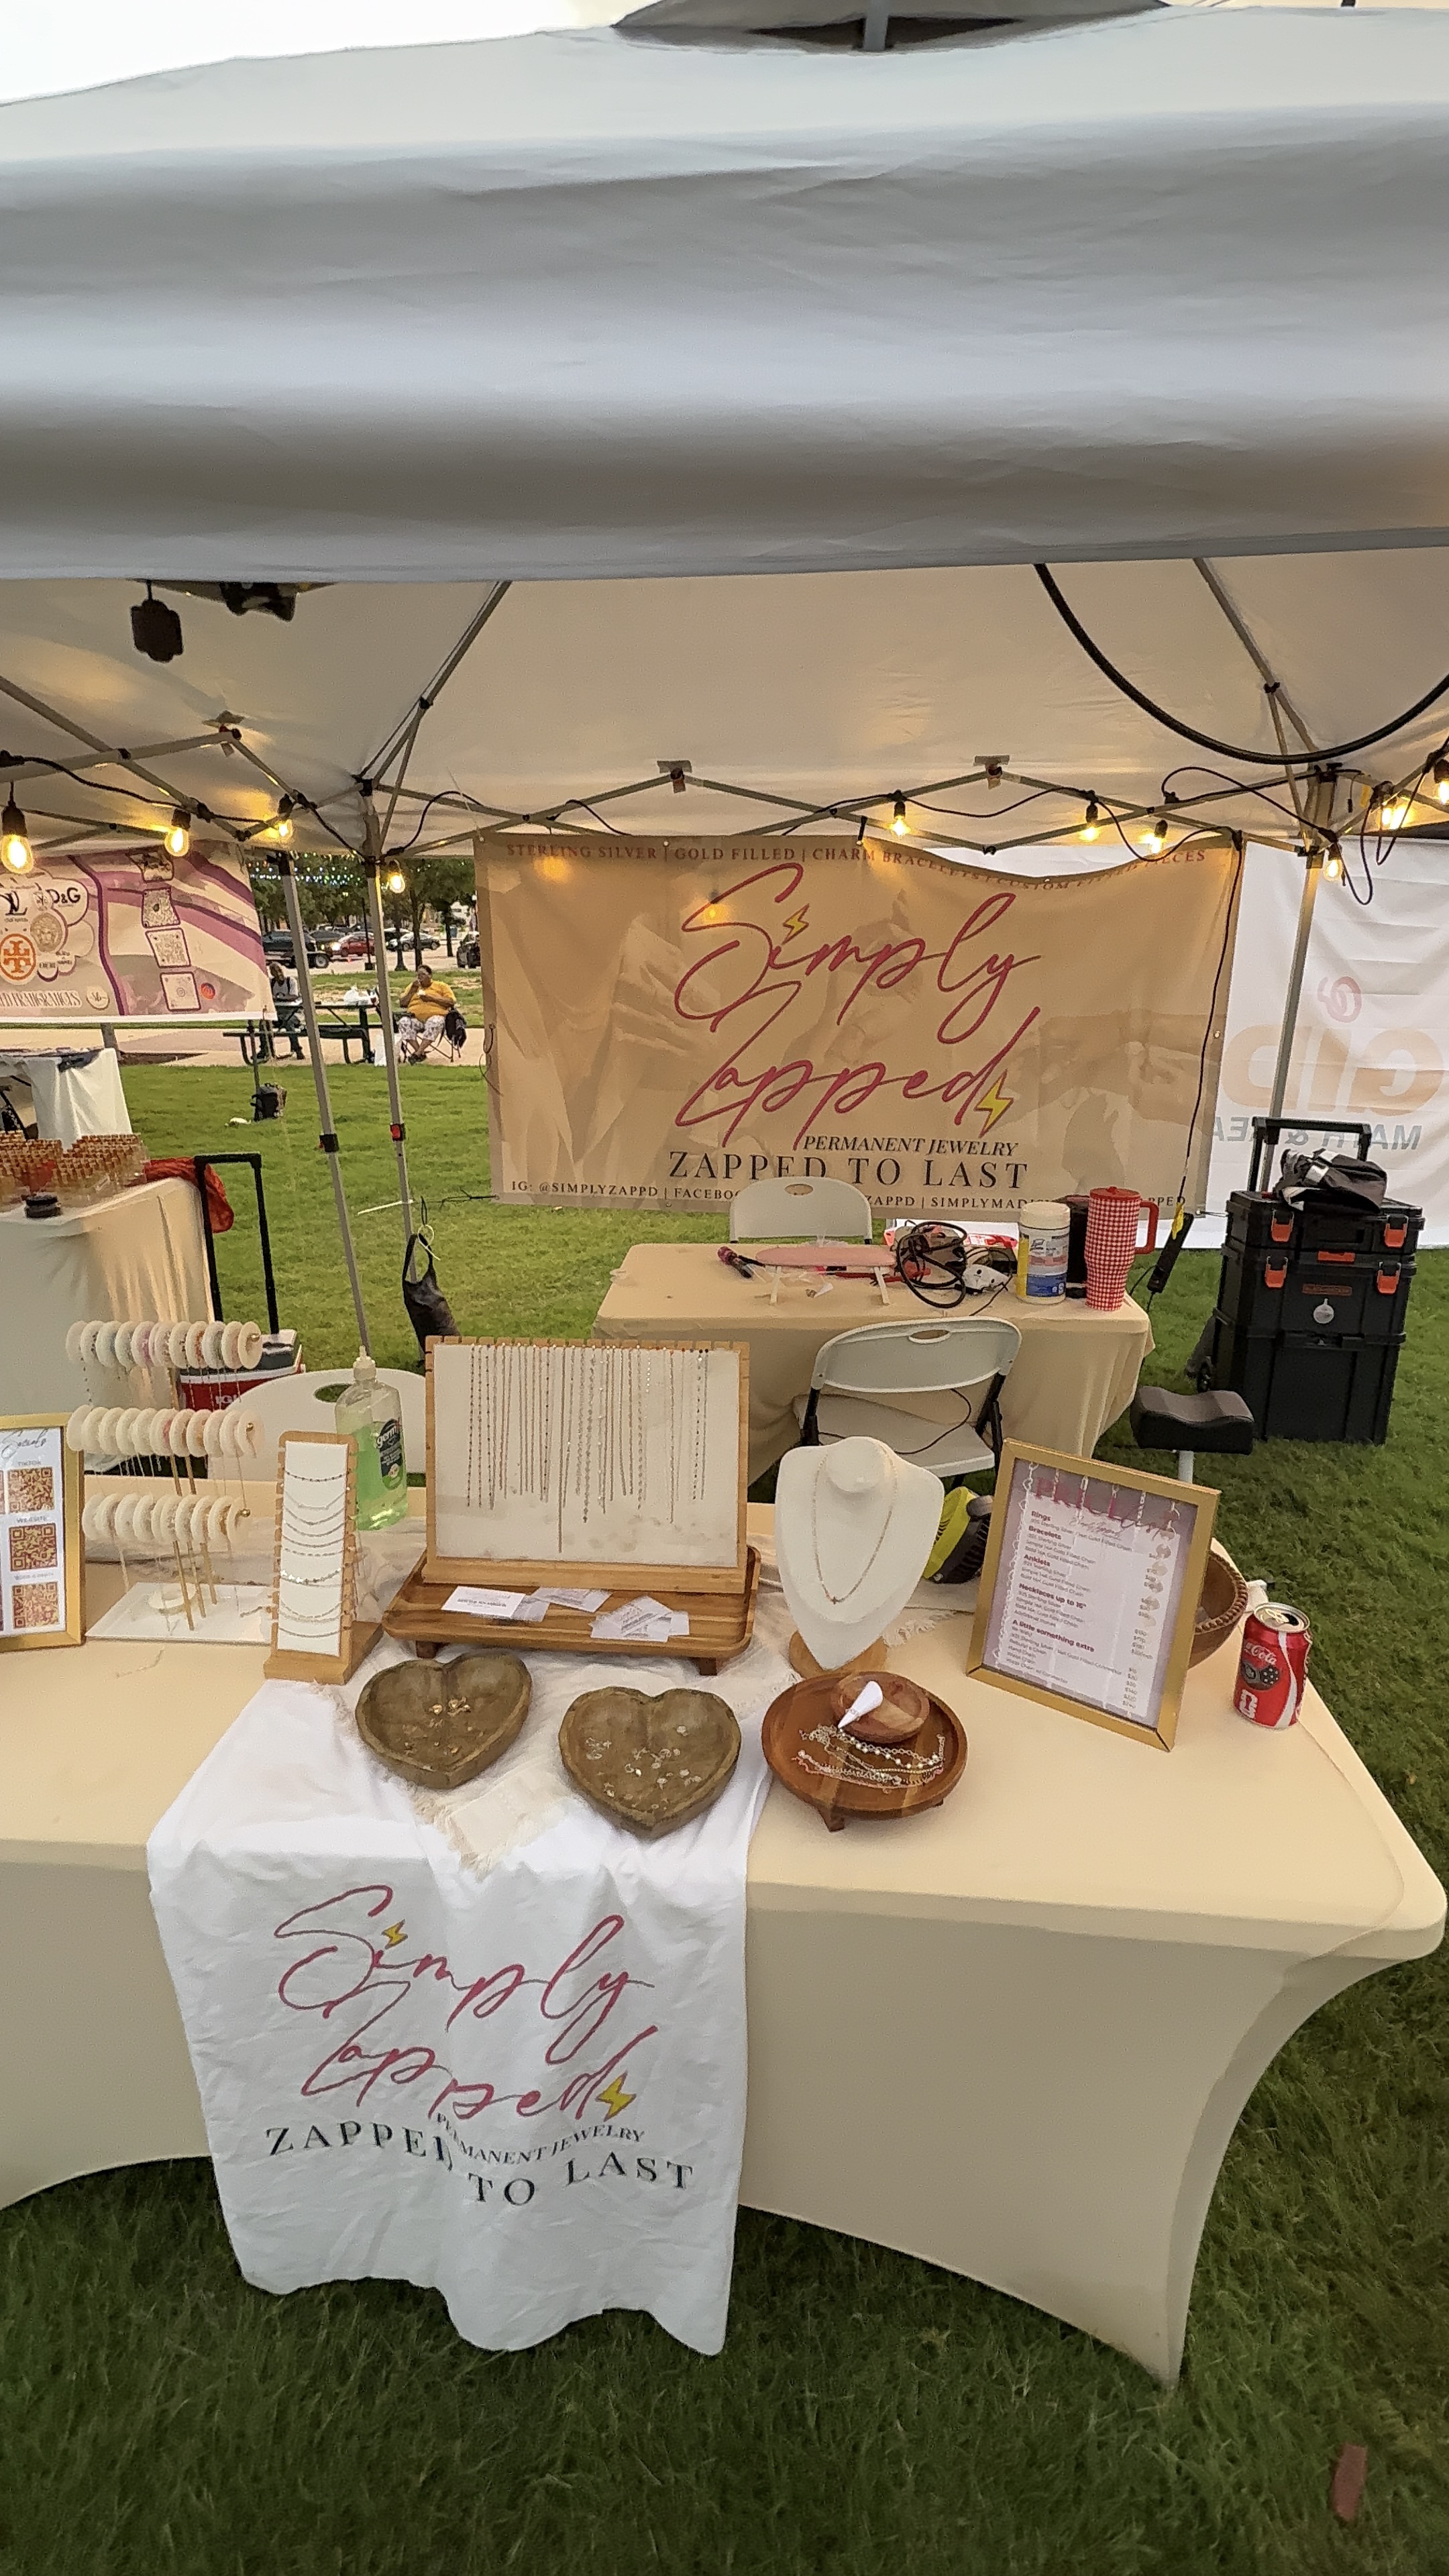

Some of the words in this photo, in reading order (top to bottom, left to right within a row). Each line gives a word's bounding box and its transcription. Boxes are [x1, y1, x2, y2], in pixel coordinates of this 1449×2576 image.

[506, 843, 592, 859] STERLING
[598, 846, 657, 860] SILVER
[674, 847, 724, 861] GOLD
[731, 847, 794, 861] FILLED
[812, 847, 875, 861] CHARM
[674, 862, 1041, 1044] Simply
[675, 981, 1041, 1150] Zapped
[803, 1135, 925, 1154] PERMANENT
[926, 1138, 1019, 1157] JEWELRY
[669, 1151, 827, 1180] ZAPPED
[848, 1158, 901, 1187] TO
[923, 1159, 1028, 1189] LAST
[512, 1181, 532, 1191] IG:
[539, 1182, 658, 1197] @SIMPLYZAPPD
[1030, 1510, 1051, 1522] Rings
[1028, 1525, 1061, 1540] Bracelets
[1023, 1554, 1051, 1567] Anklets
[1018, 1582, 1055, 1599] Necklaces
[1055, 1595, 1065, 1604] up
[1019, 1620, 1035, 1631] little
[1036, 1627, 1074, 1646] something
[1075, 1641, 1094, 1652] extra
[273, 1884, 655, 2065] Simply
[301, 1980, 658, 2120] Zapped
[548, 2124, 646, 2163] JEWELRY
[468, 2171, 537, 2206] TO
[565, 2151, 694, 2190] LAST
